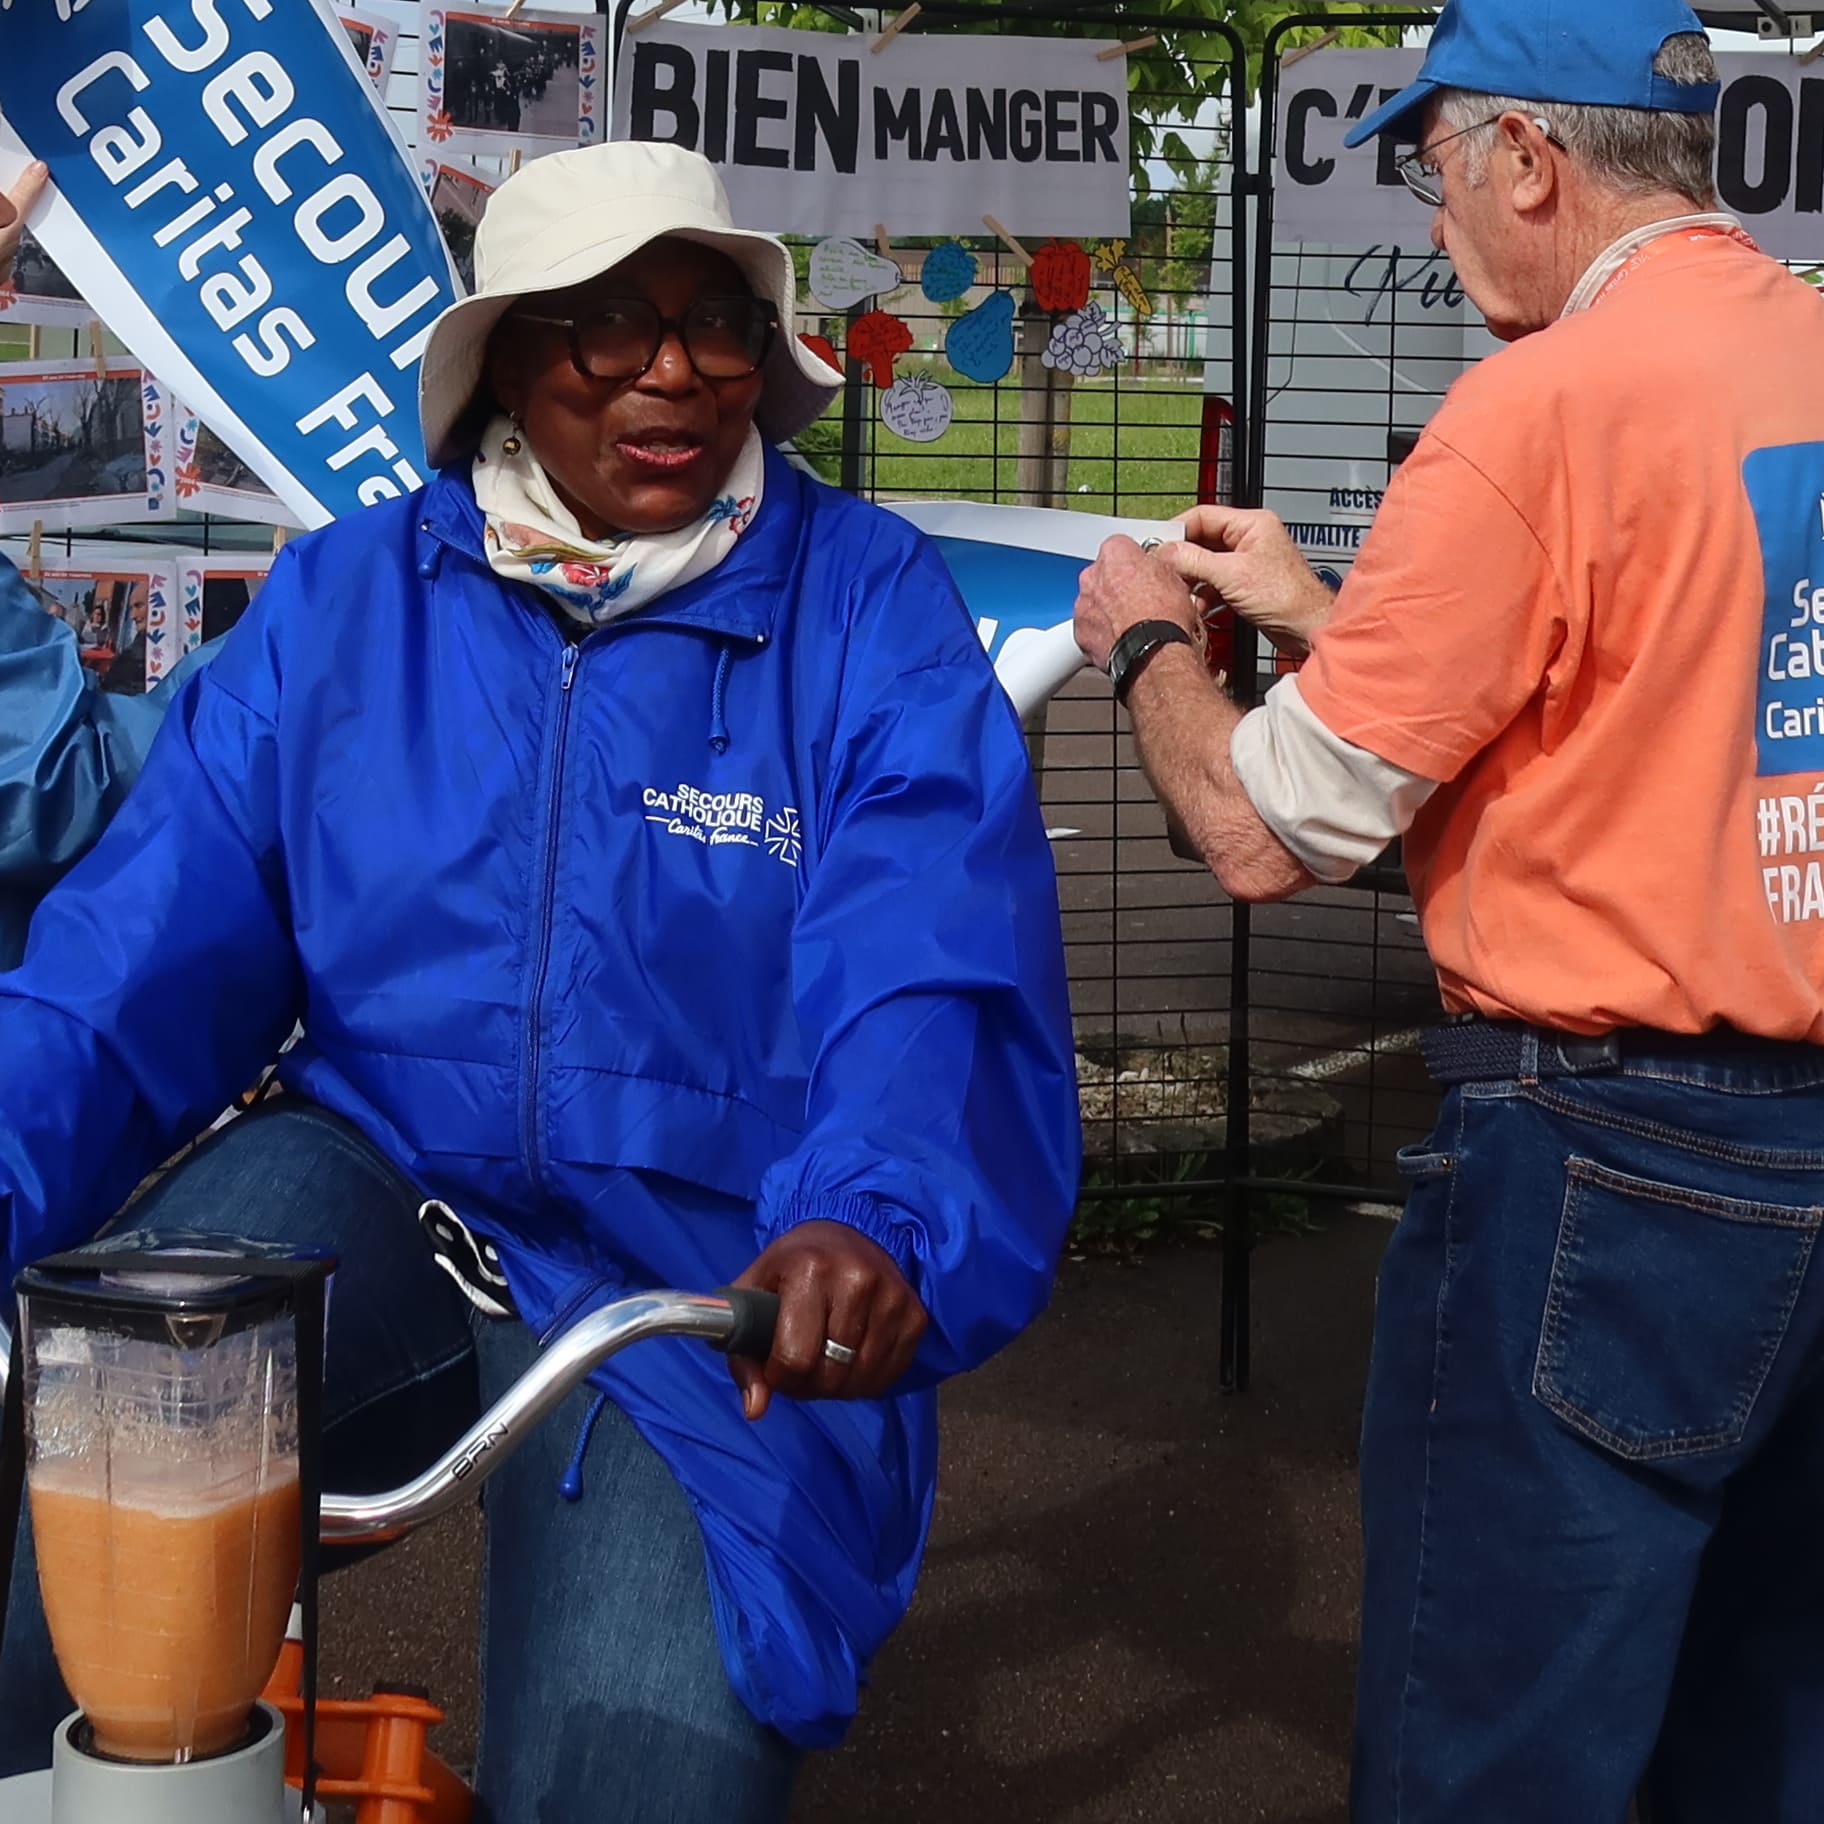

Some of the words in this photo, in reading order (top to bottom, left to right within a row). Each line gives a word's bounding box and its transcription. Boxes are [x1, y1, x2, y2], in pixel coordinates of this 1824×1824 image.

[630, 41, 861, 174] BIEN
[873, 86, 1121, 163] MANGER
[55, 49, 317, 378] Caritas
[642, 788, 764, 833] CATHOLIQUE
[677, 783, 764, 814] SECOURS
